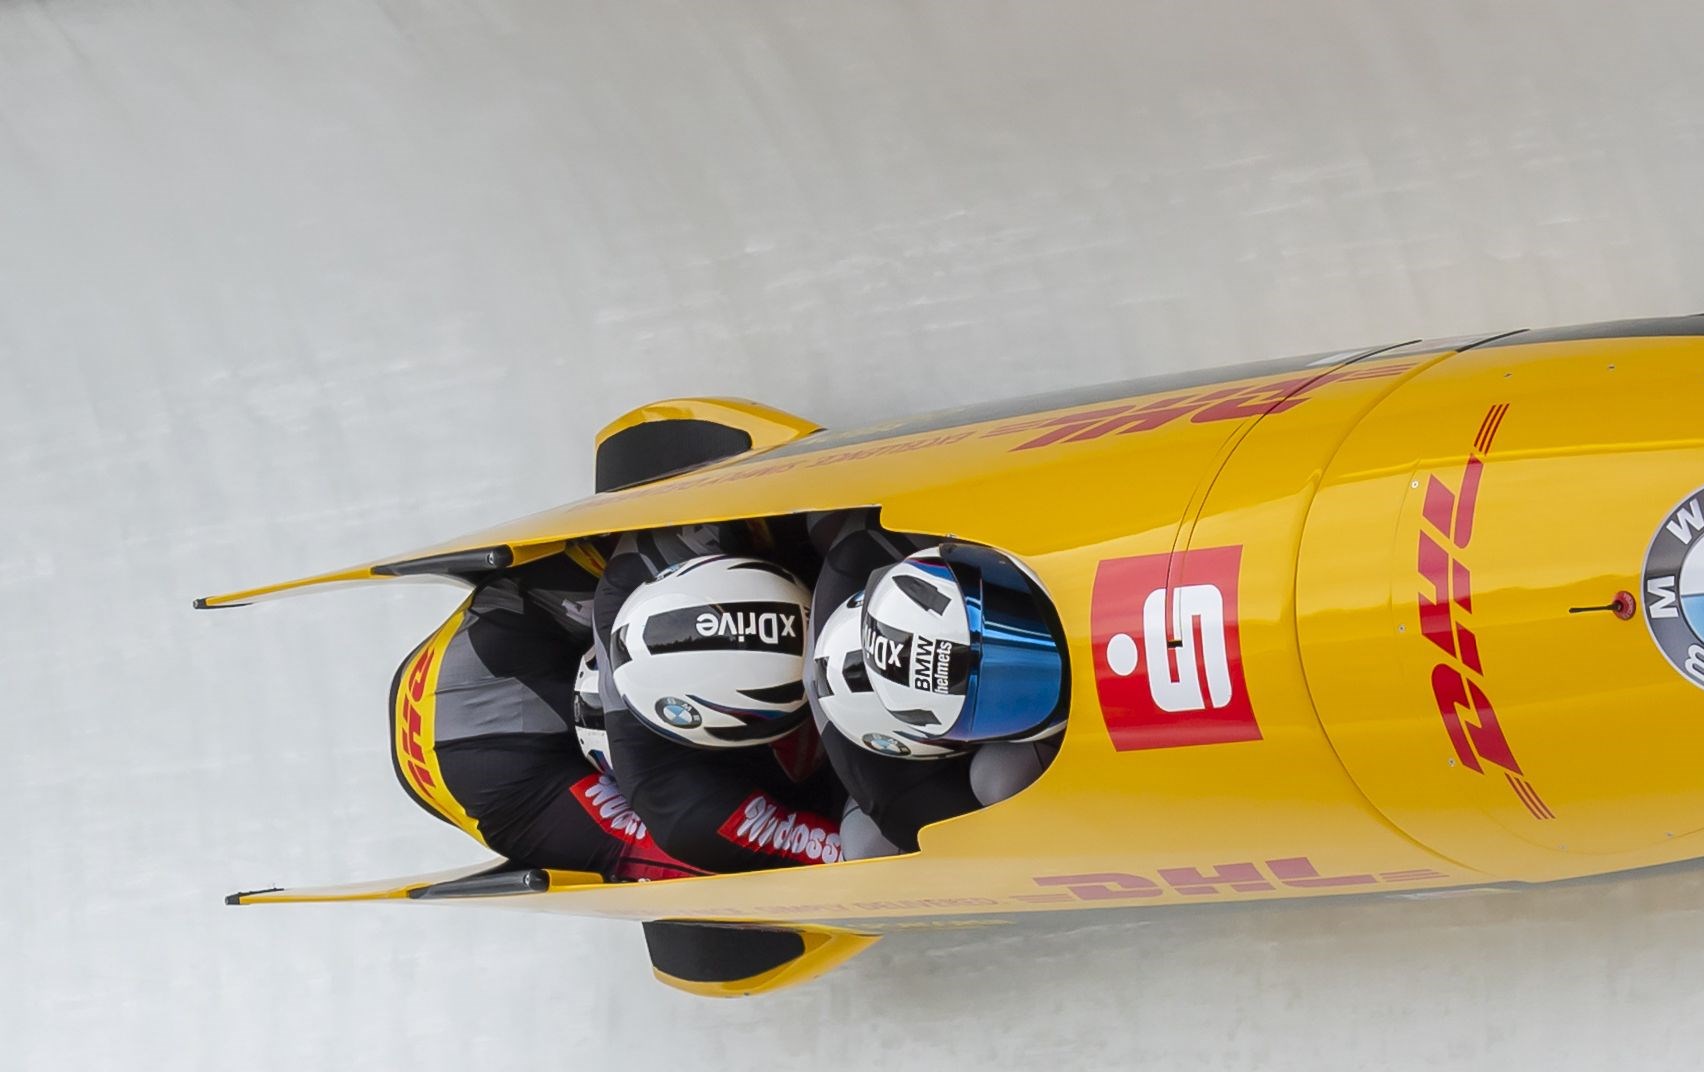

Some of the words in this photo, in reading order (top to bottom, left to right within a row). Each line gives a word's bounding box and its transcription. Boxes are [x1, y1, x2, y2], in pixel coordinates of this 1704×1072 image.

[1010, 370, 1358, 452] DHL
[696, 611, 796, 645] xDrive
[1418, 452, 1525, 776] DHL
[914, 635, 934, 692] BMW
[933, 640, 952, 695] helmets
[1033, 857, 1378, 901] DHL
